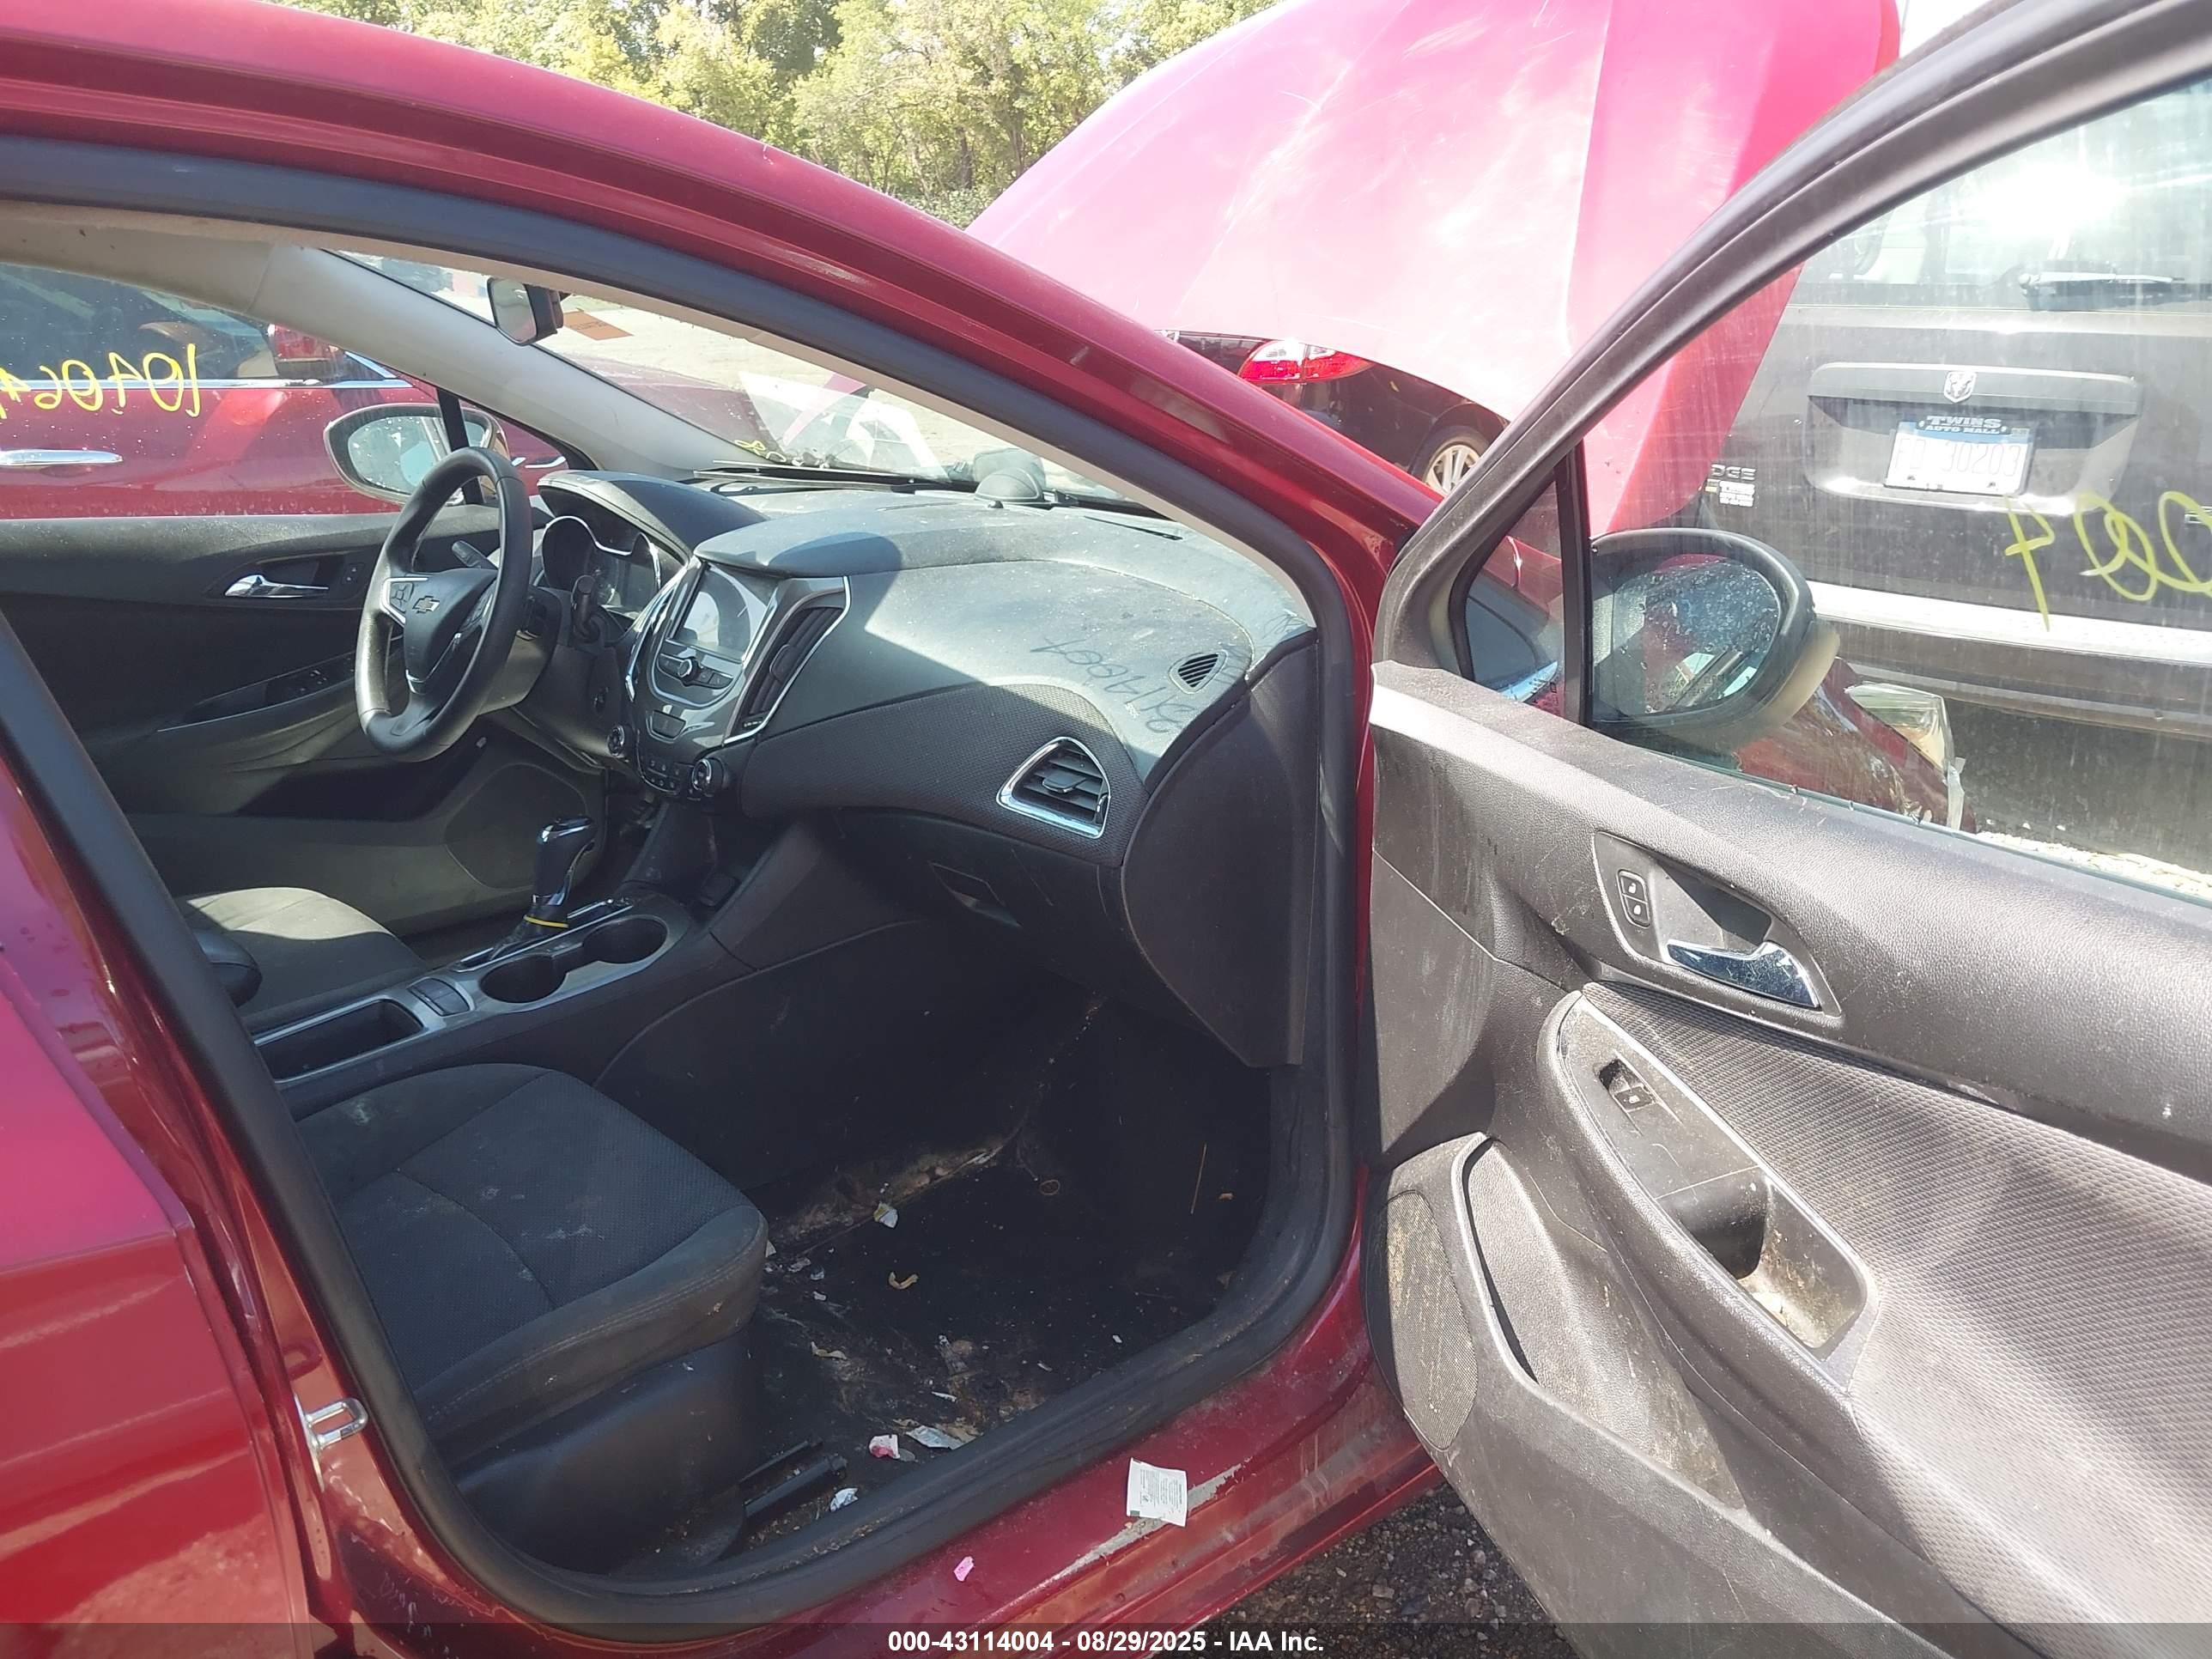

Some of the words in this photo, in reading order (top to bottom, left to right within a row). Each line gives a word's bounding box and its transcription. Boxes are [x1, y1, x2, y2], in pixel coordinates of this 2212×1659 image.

[1926, 415, 2002, 428] TWINS
[1924, 424, 1960, 433] AUTO
[1964, 426, 2000, 434] MALL
